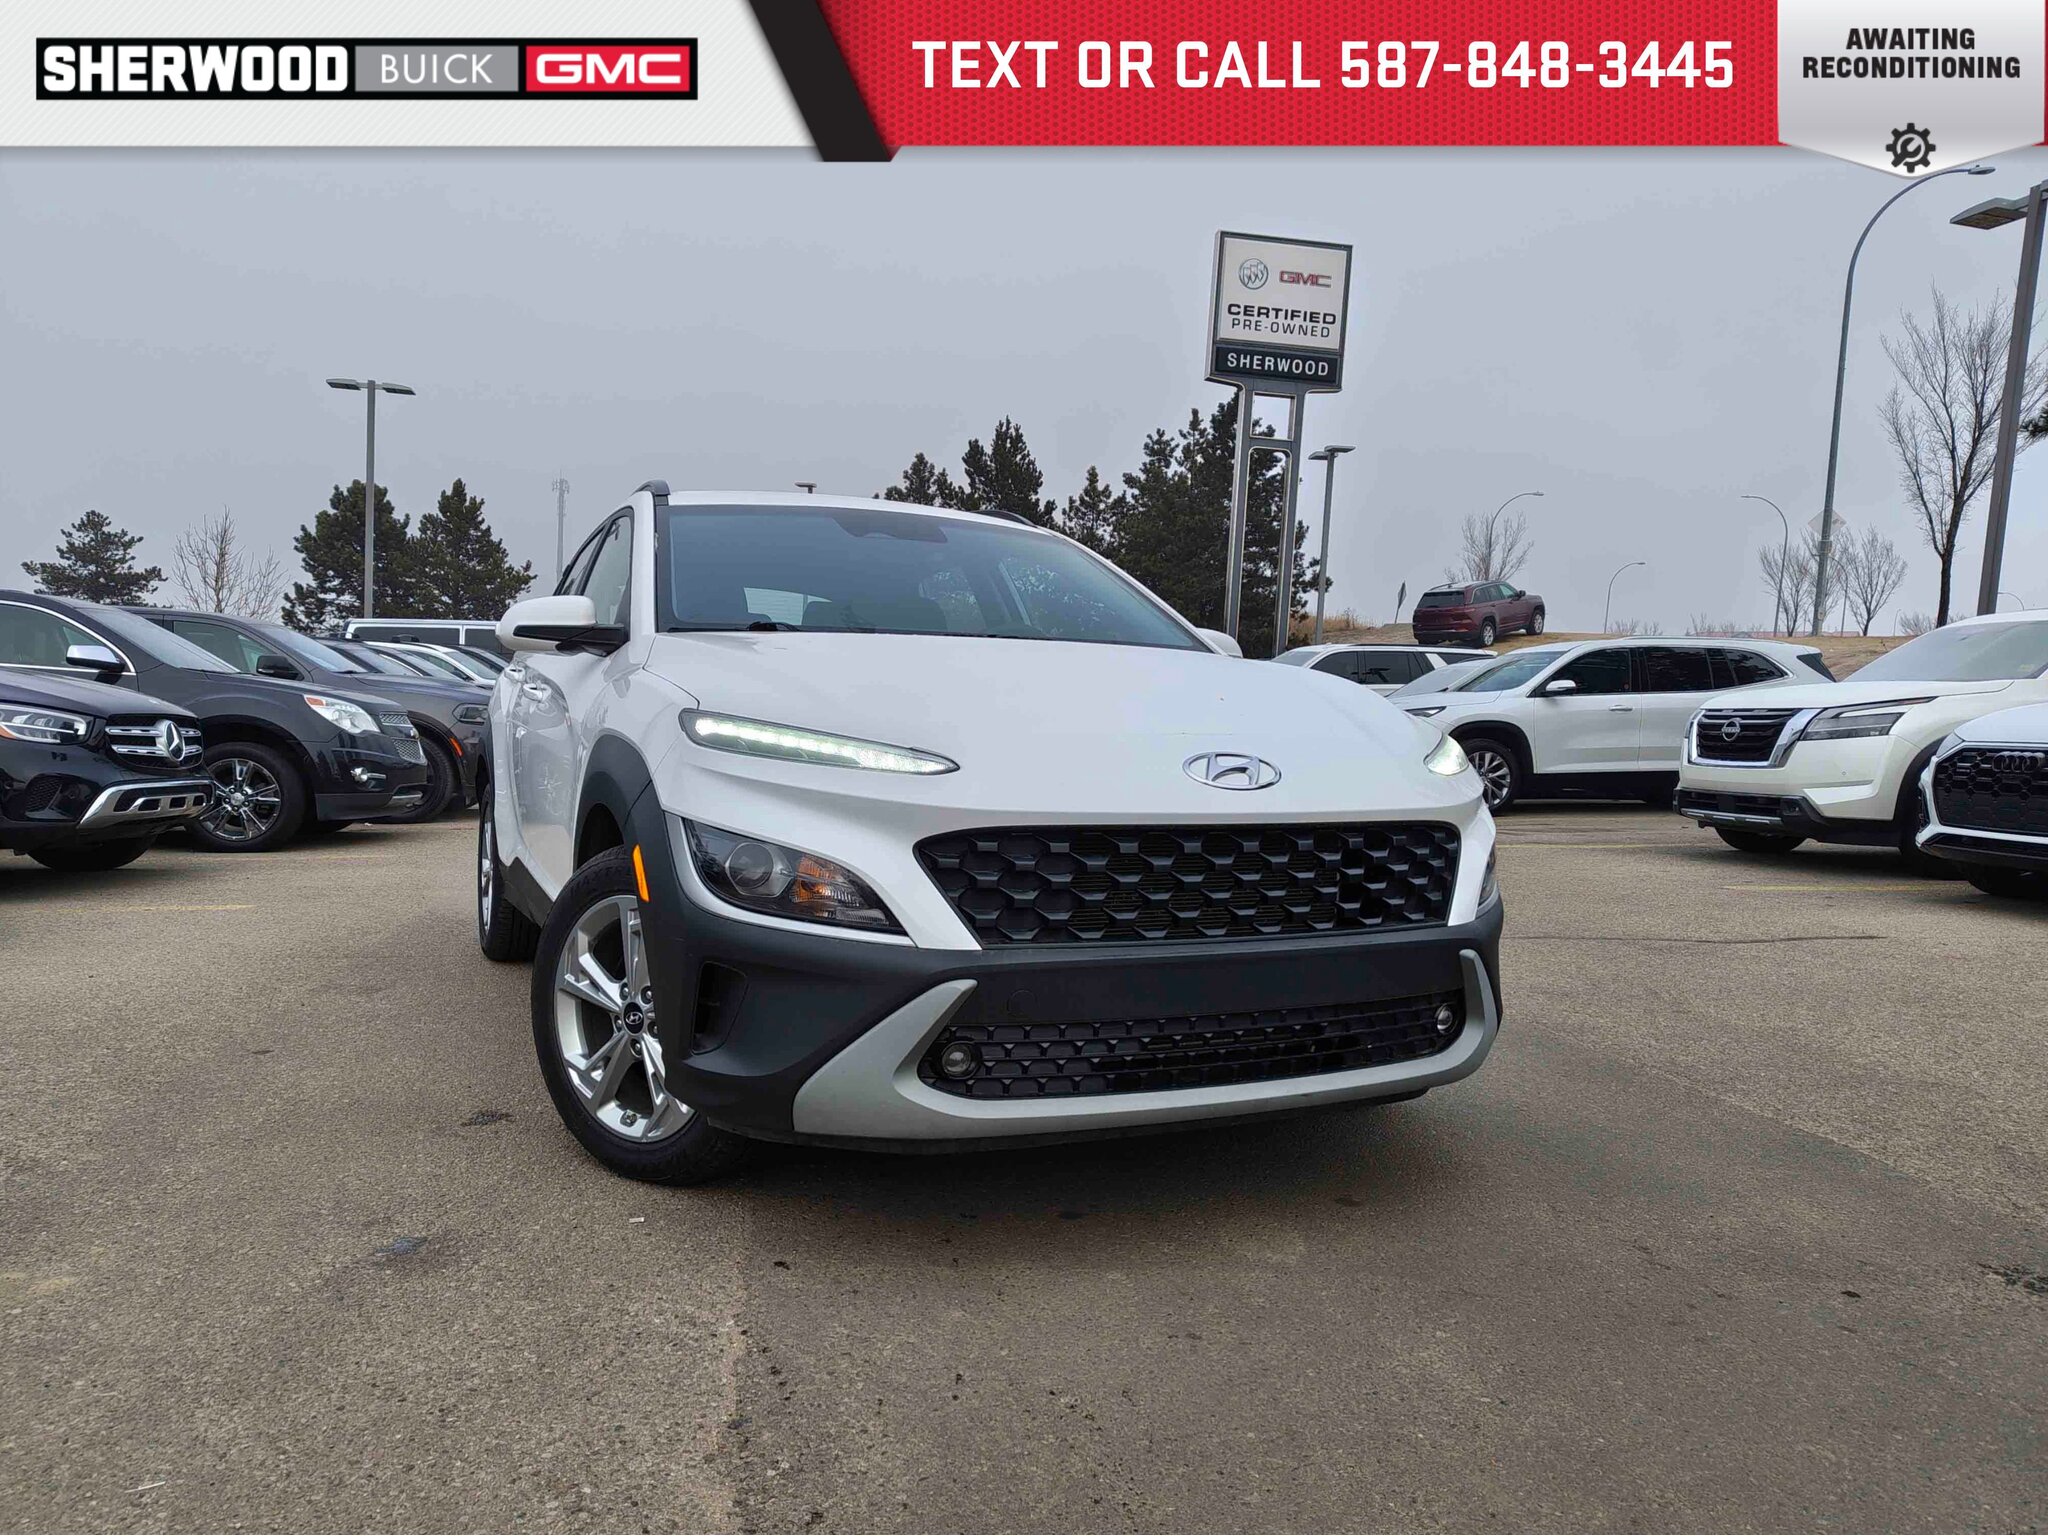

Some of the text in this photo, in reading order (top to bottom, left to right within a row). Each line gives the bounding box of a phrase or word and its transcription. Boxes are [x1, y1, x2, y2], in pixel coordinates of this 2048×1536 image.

[1279, 270, 1332, 288] GMC
[1227, 303, 1336, 325] CERTIFIED
[1231, 318, 1331, 338] PRE-OWNED
[1227, 352, 1329, 376] SHERWOOD
